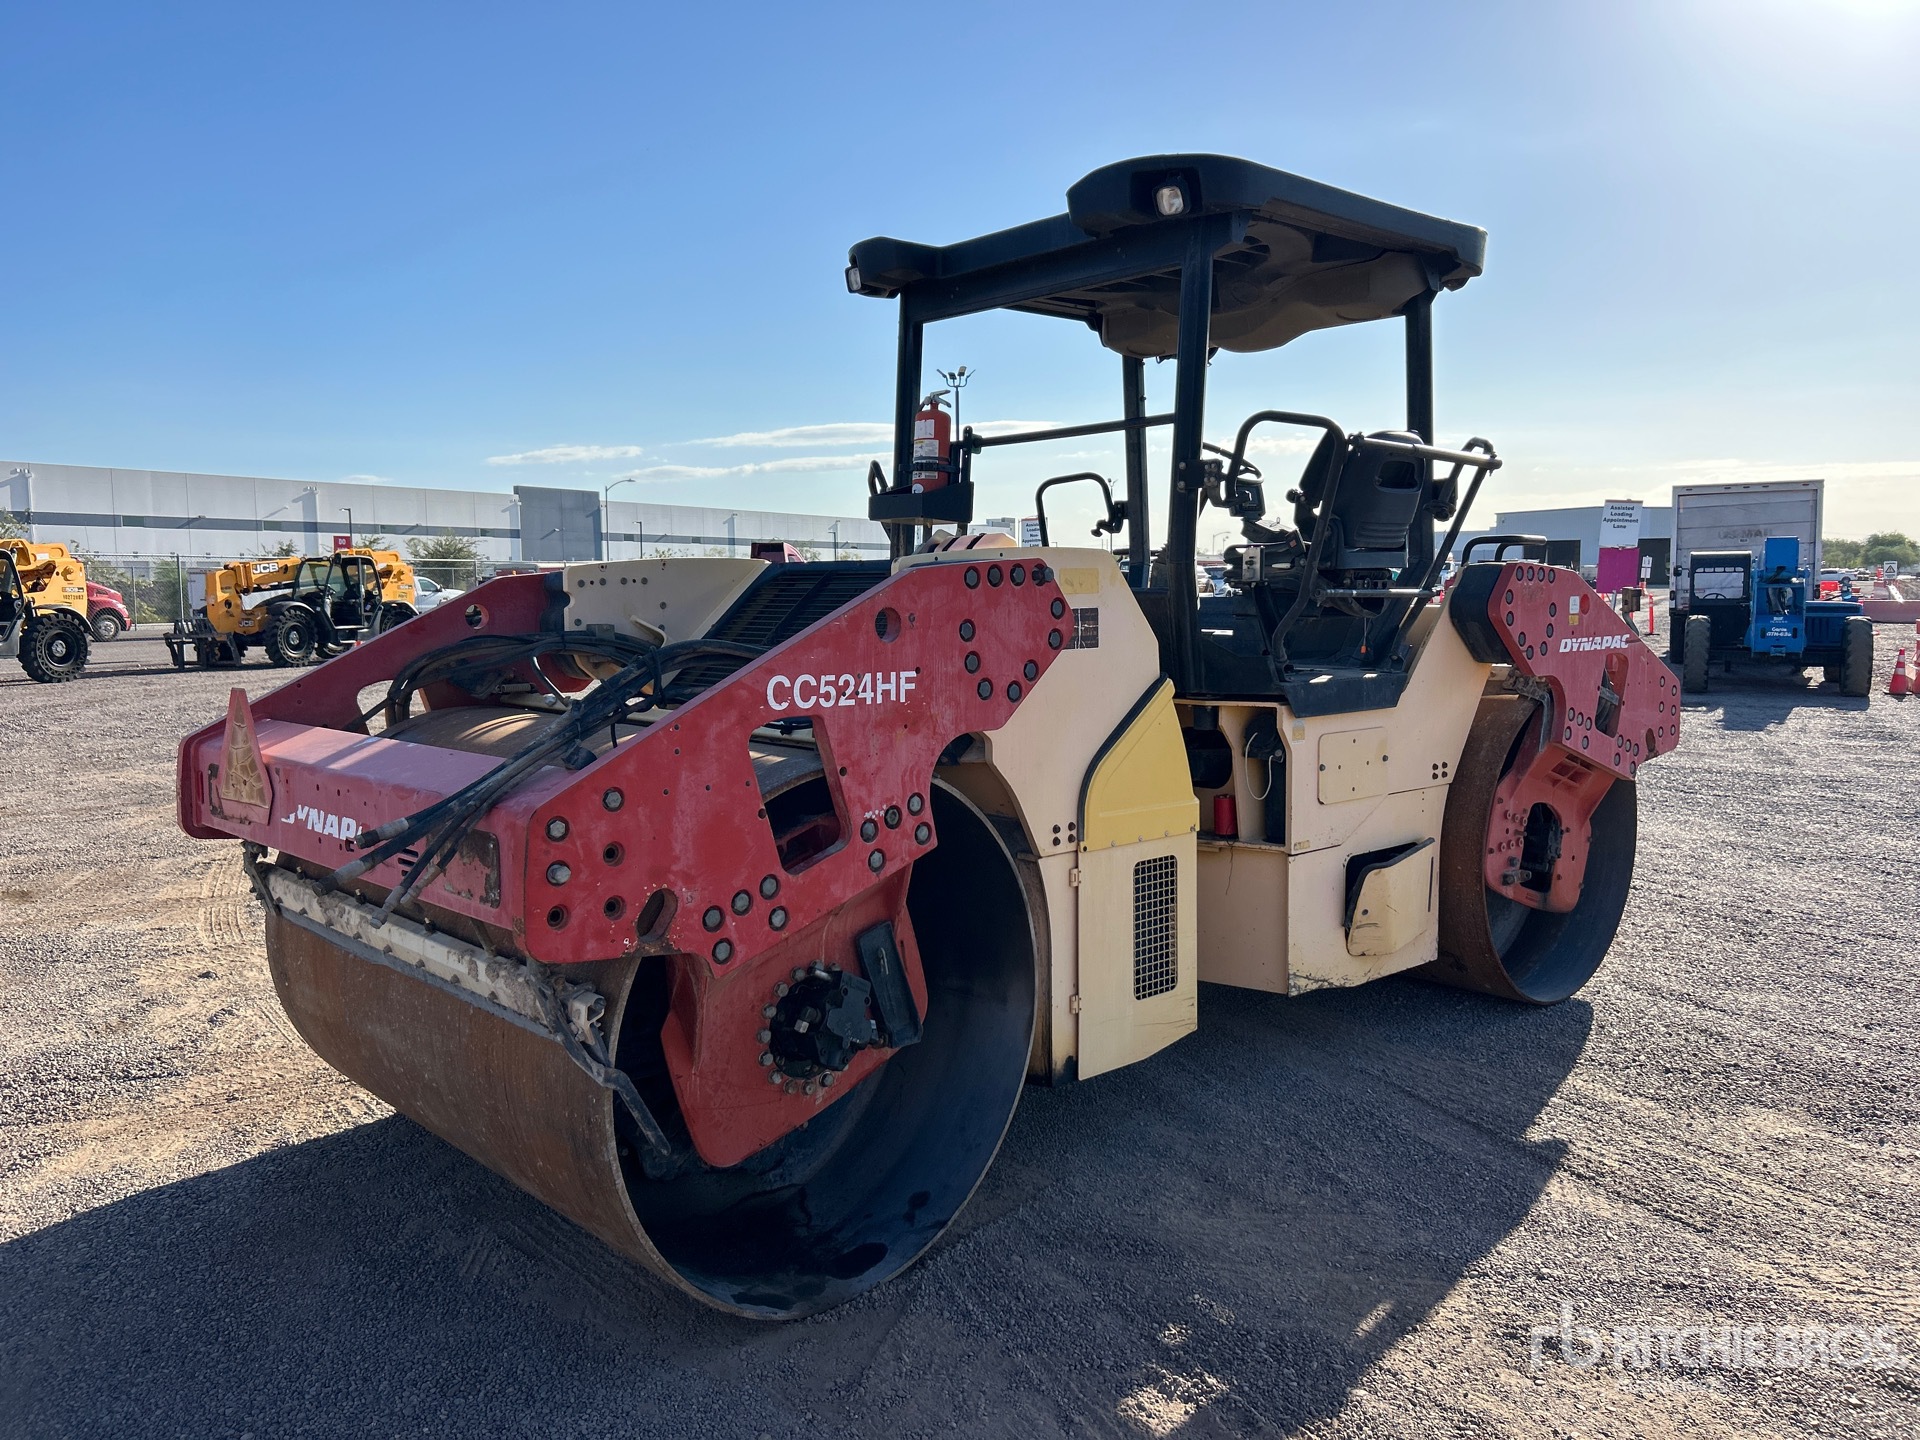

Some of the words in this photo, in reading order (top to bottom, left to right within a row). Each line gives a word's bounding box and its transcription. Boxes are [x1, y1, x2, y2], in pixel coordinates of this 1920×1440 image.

[252, 562, 279, 574] JCB
[1559, 633, 1631, 653] DYNAPAC
[766, 671, 917, 711] CC524HF
